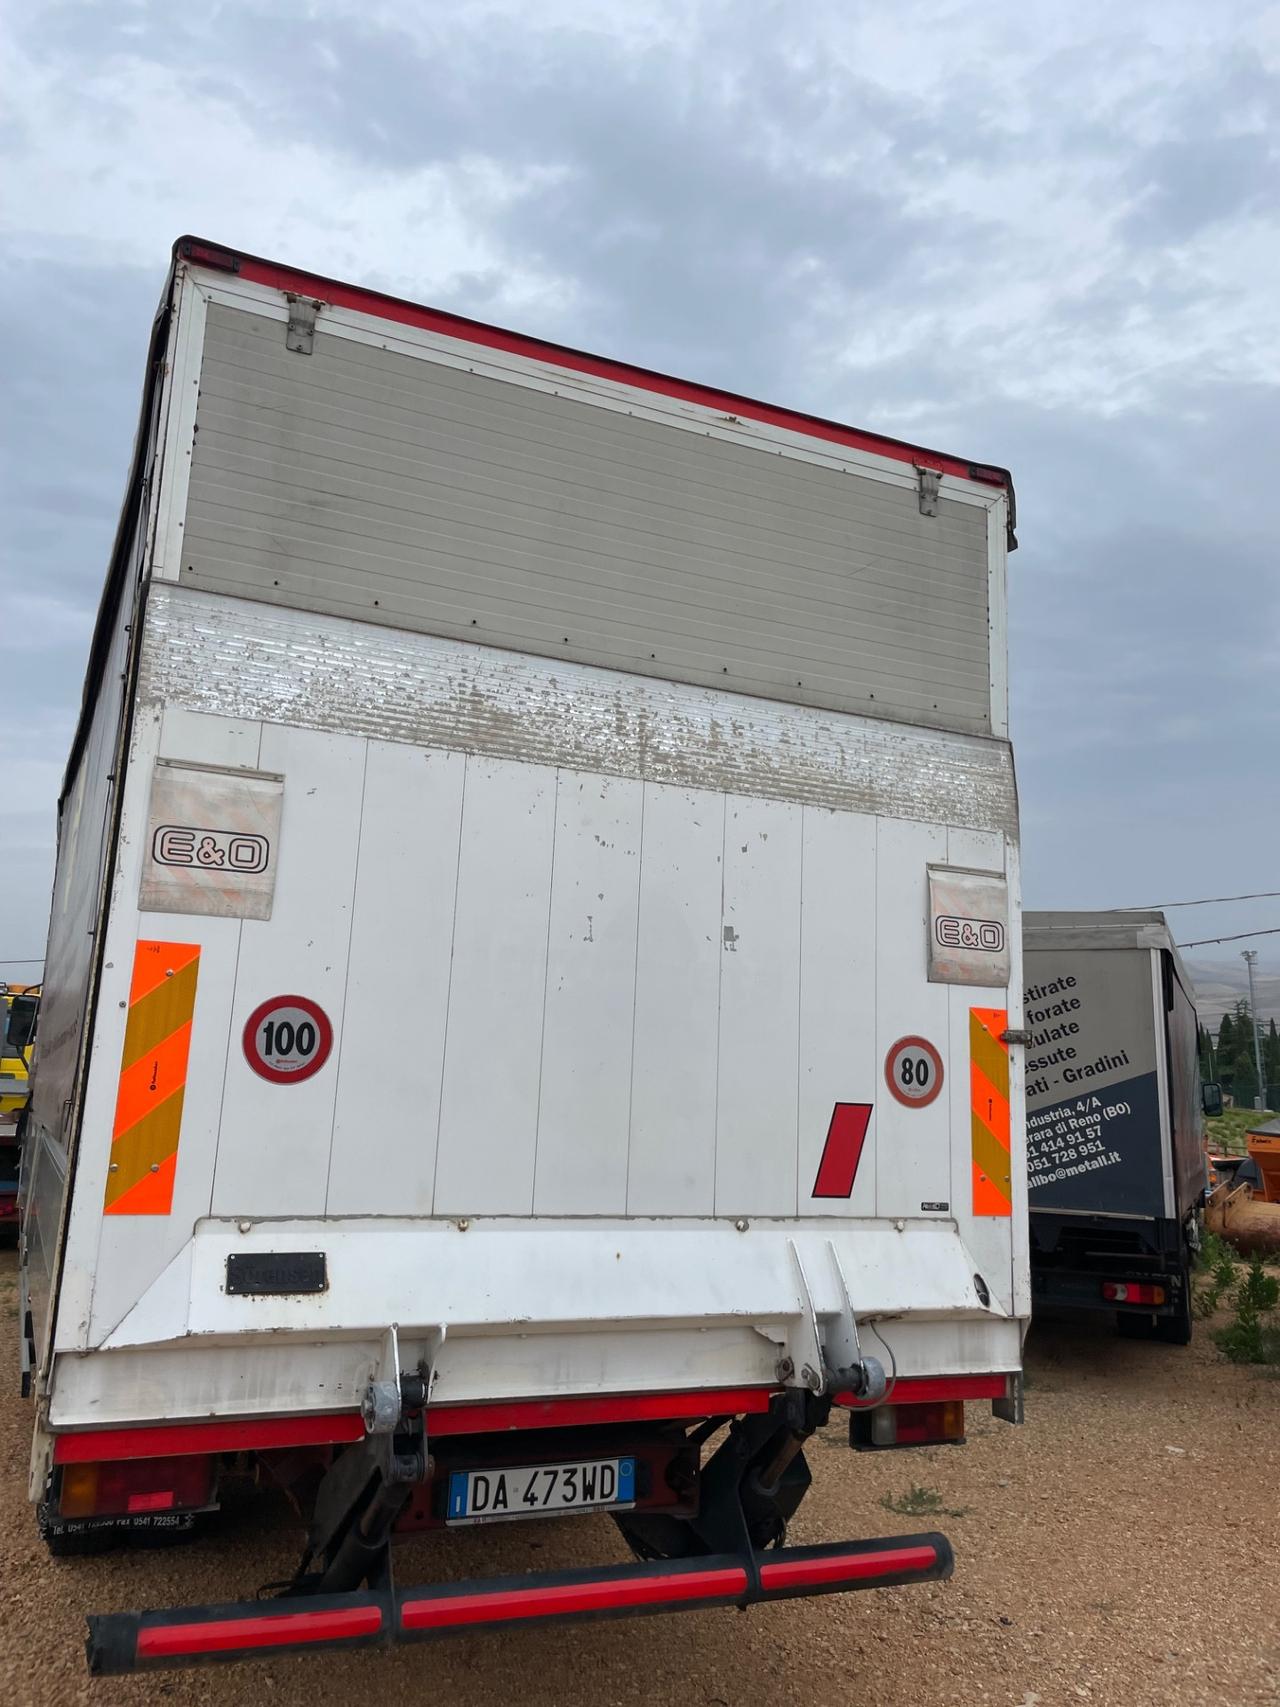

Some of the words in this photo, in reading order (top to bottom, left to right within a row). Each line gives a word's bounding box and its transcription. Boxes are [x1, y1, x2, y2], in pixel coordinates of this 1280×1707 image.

[160, 830, 262, 870] E&O
[940, 919, 1000, 949] E&O
[1027, 998, 1081, 1025] forate
[263, 1021, 316, 1056] 100
[1032, 1021, 1080, 1048] ulate
[901, 1057, 929, 1087] 80
[1062, 1049, 1130, 1084] Gradini
[1055, 1121, 1068, 1134] di
[1068, 1112, 1101, 1130] Reno
[1102, 1101, 1131, 1121] (BO)
[1076, 1096, 1102, 1113] 4/A
[1040, 1137, 1065, 1153] 414
[1066, 1131, 1085, 1145] 91
[1086, 1125, 1101, 1139] 57
[1027, 1156, 1052, 1173] 051
[1051, 1148, 1078, 1164] 728
[1079, 1140, 1106, 1156] 951
[471, 1473, 509, 1512] DA
[522, 1464, 616, 1507] 473WD
[133, 1517, 151, 1527] 0541
